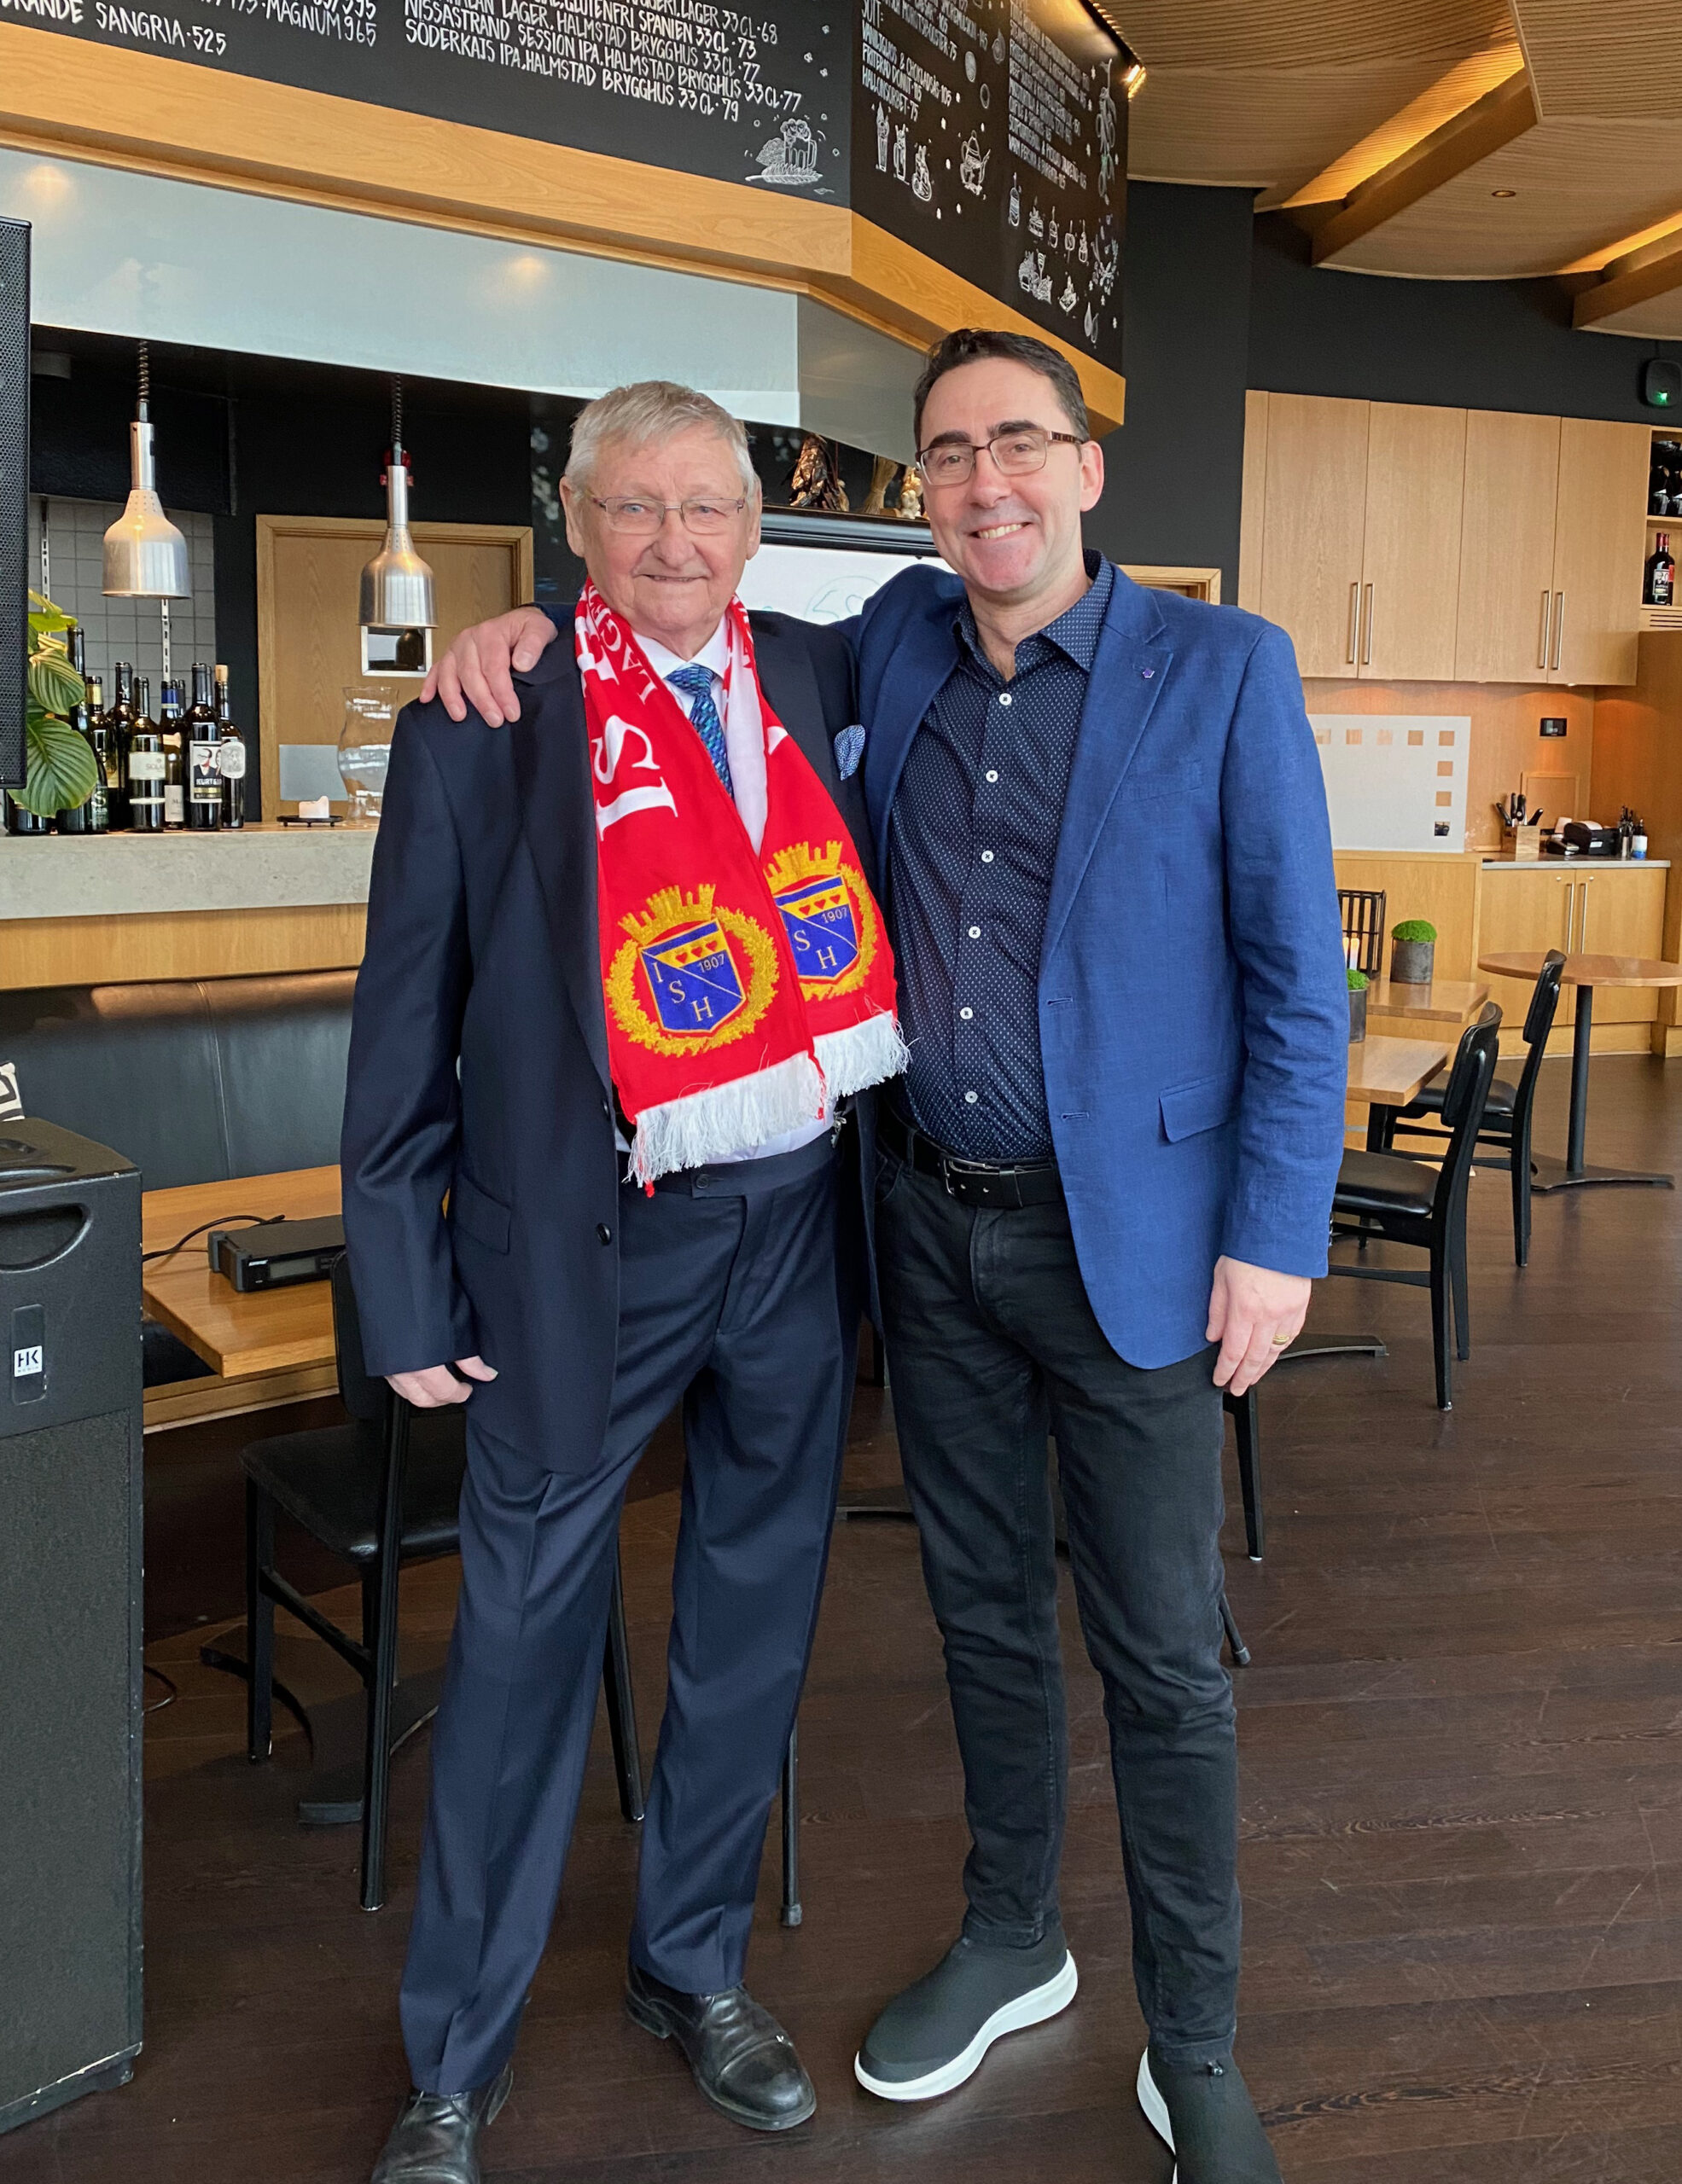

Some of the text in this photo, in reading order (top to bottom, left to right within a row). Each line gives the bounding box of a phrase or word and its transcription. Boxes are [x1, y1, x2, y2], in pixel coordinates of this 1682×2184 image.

[638, 9, 693, 44] SPANIEN
[680, 0, 720, 28] LAGER
[344, 15, 377, 47] 965
[556, 10, 627, 49] HALMSTAD
[631, 30, 698, 67] BRYGGHUS
[404, 0, 509, 41] NISSASTRAND
[518, 23, 576, 60] SESSION
[604, 46, 674, 83] HALMSTAD
[678, 66, 741, 99] BRYGGHUS
[526, 49, 597, 86] HALMSTAD
[602, 68, 674, 106] BRYGGHUS
[820, 907, 848, 924] 1907
[696, 953, 725, 973] 1907
[18, 1350, 39, 1368] HK
